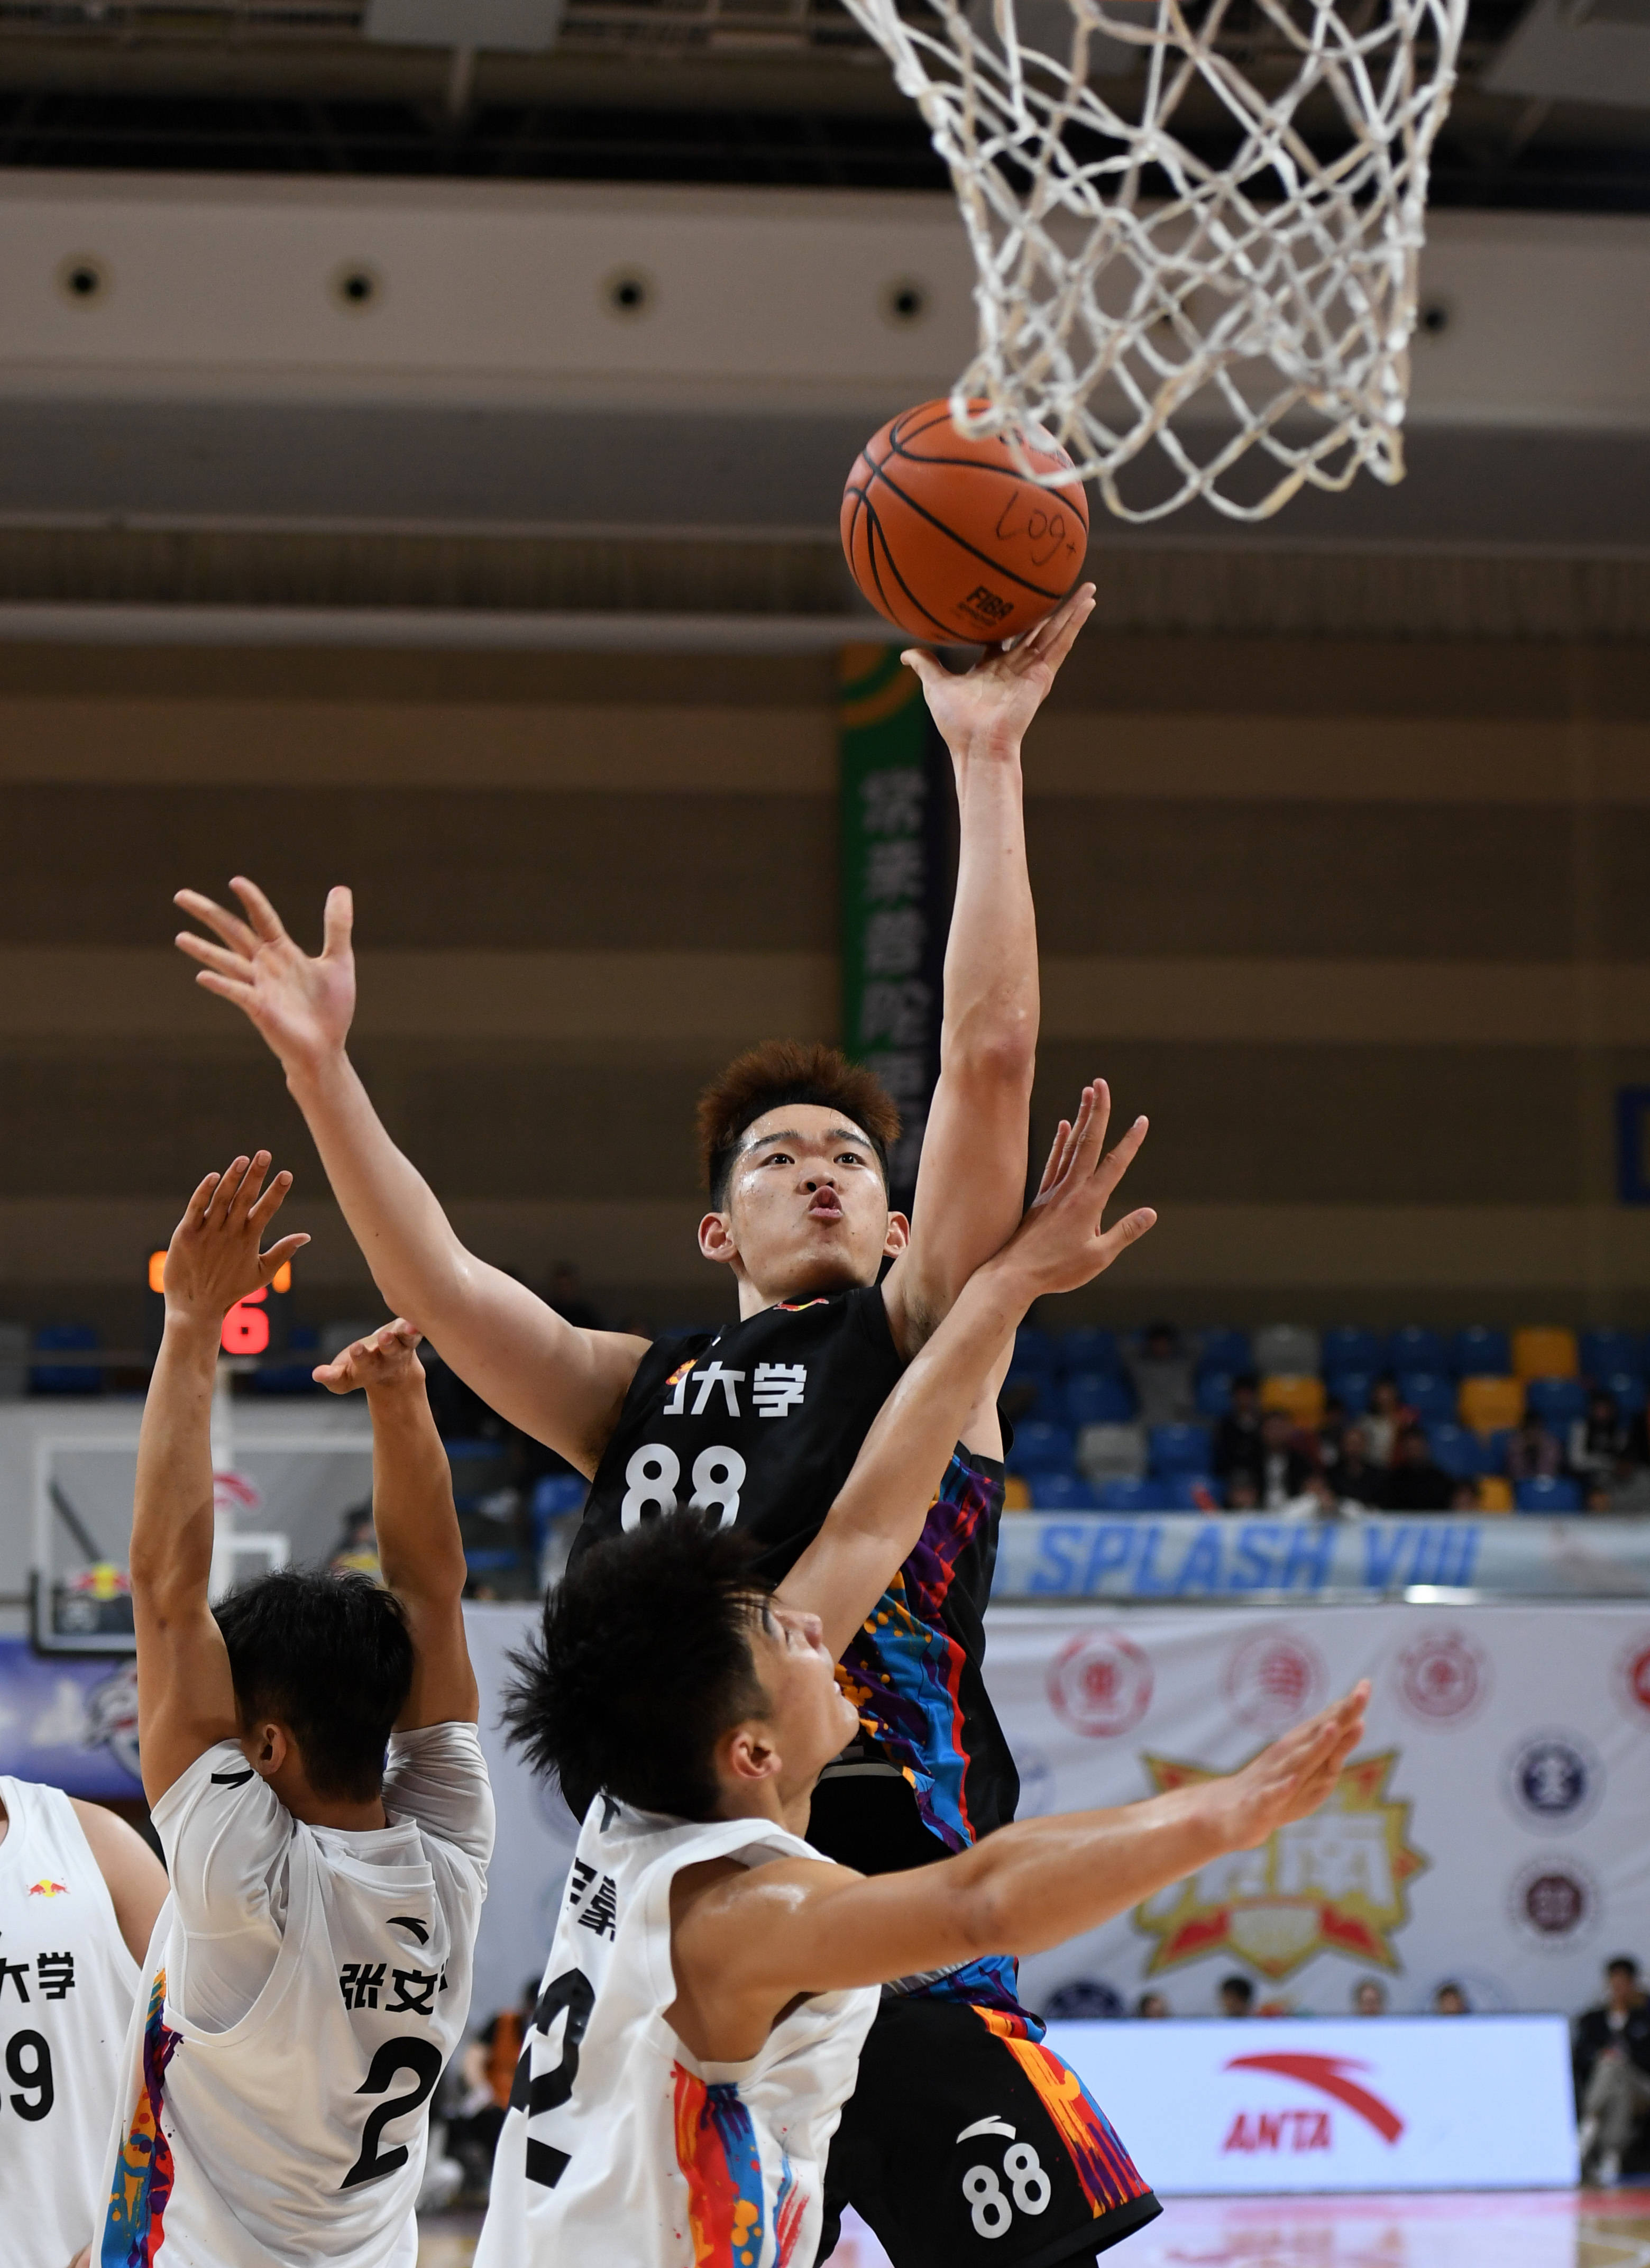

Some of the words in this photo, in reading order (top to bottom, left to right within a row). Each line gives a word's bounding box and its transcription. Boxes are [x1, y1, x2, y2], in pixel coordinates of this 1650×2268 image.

[621, 1443, 747, 1533] 88
[1027, 1524, 1337, 1593] SPLASH
[340, 1959, 448, 2015] 张文
[0, 2029, 54, 2122] 9
[339, 2036, 442, 2190] 2
[1223, 2112, 1331, 2151] ANTA
[962, 2143, 1051, 2239] 88
